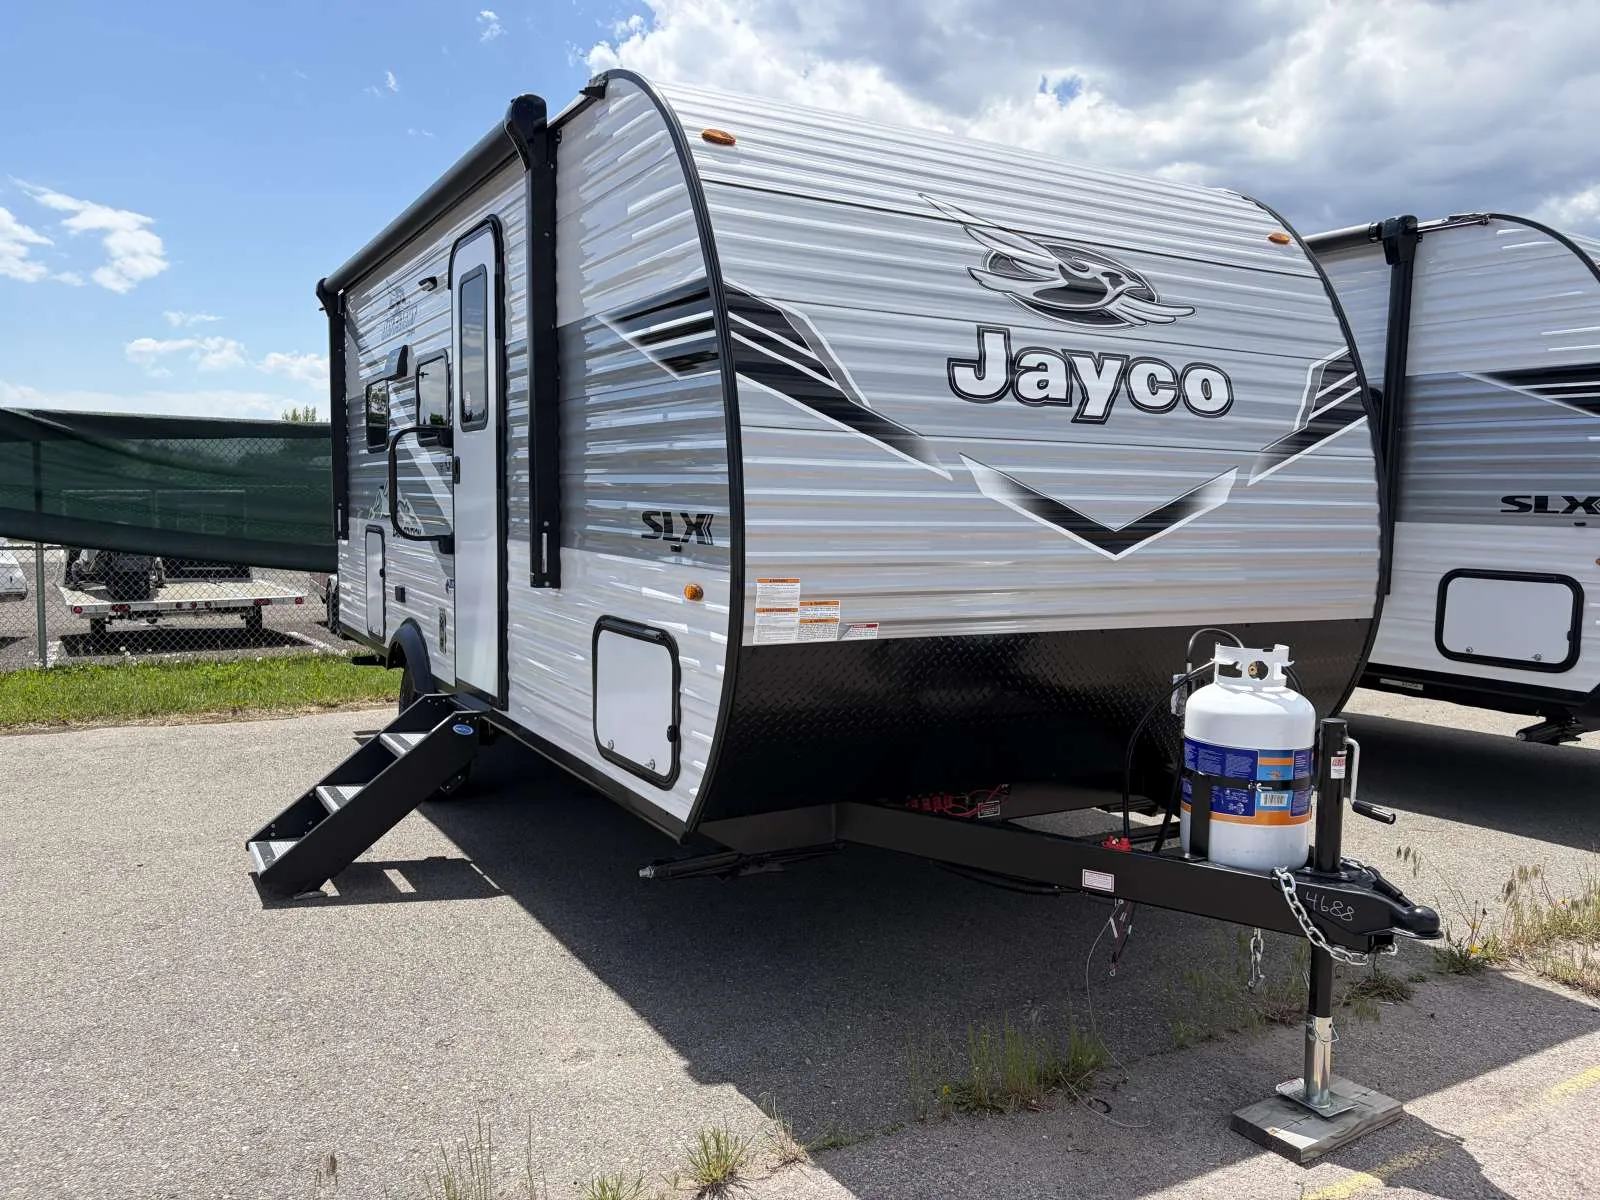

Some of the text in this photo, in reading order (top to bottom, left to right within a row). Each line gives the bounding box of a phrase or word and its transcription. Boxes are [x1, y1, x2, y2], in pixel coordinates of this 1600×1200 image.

[947, 325, 1235, 424] Jayco
[1500, 495, 1600, 515] SLX
[641, 510, 714, 545] SLX
[1305, 891, 1355, 922] 4688
